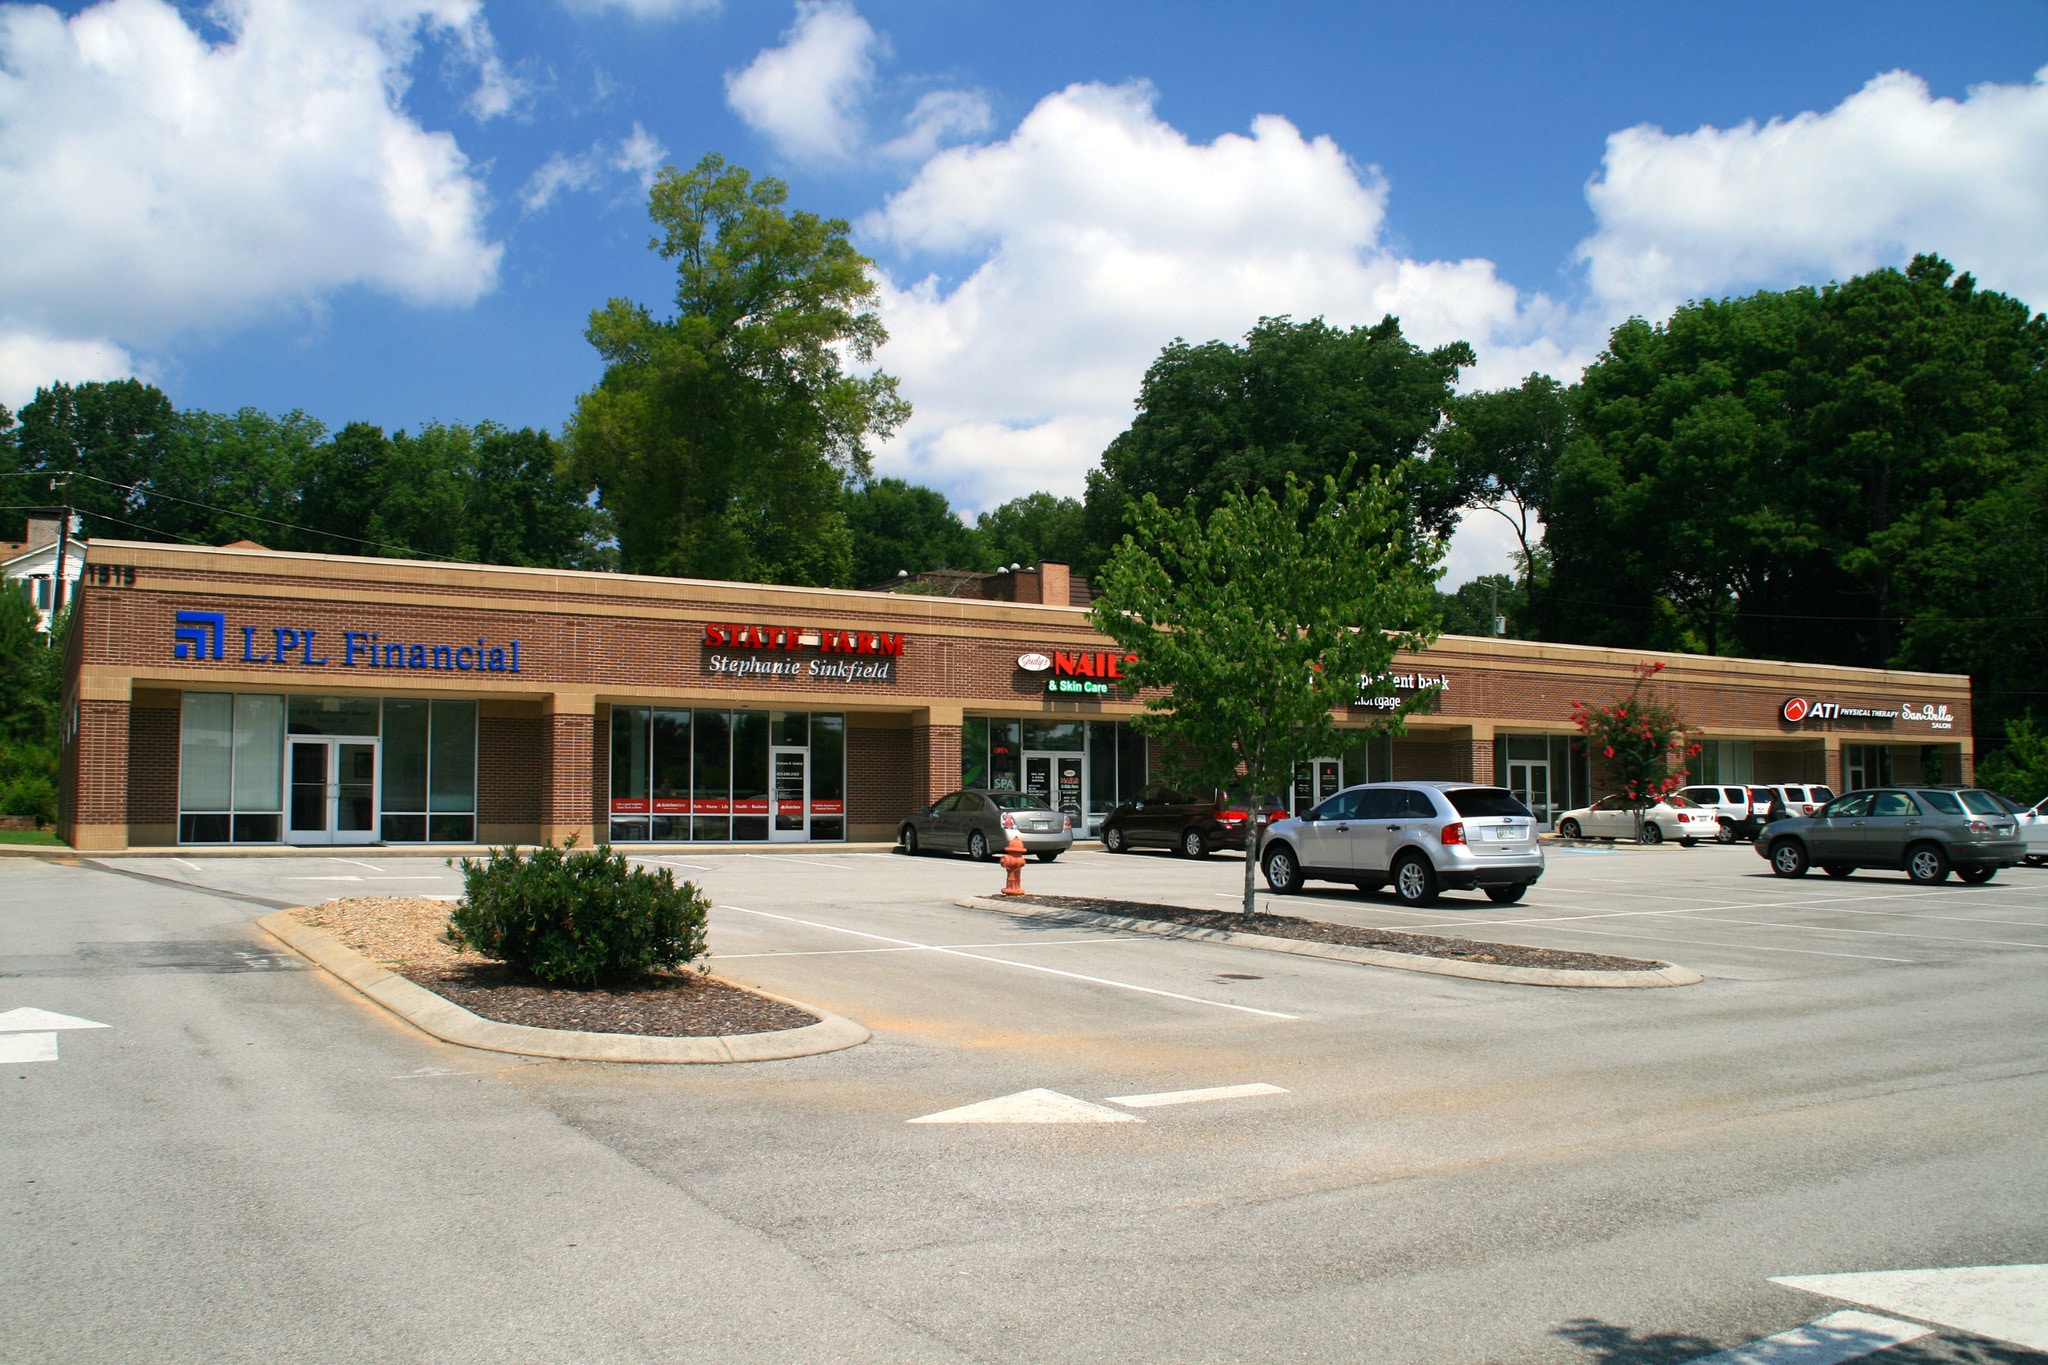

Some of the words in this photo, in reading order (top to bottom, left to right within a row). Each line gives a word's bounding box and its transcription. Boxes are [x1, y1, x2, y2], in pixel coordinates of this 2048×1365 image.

[704, 622, 804, 650] STATE
[819, 629, 905, 656] FARM
[239, 626, 328, 665] LPL
[342, 631, 521, 672] Financial
[709, 655, 800, 677] Stephanie
[808, 659, 890, 683] Sinkfield
[1021, 654, 1048, 670] Judy's
[1049, 680, 1057, 691] &
[1060, 680, 1082, 692] Skin
[1084, 682, 1108, 693] Care
[1808, 703, 1839, 719] ATI
[1840, 708, 1871, 717] PHYSICAL
[1871, 709, 1899, 719] THERAPY
[994, 779, 1015, 789] SPA
